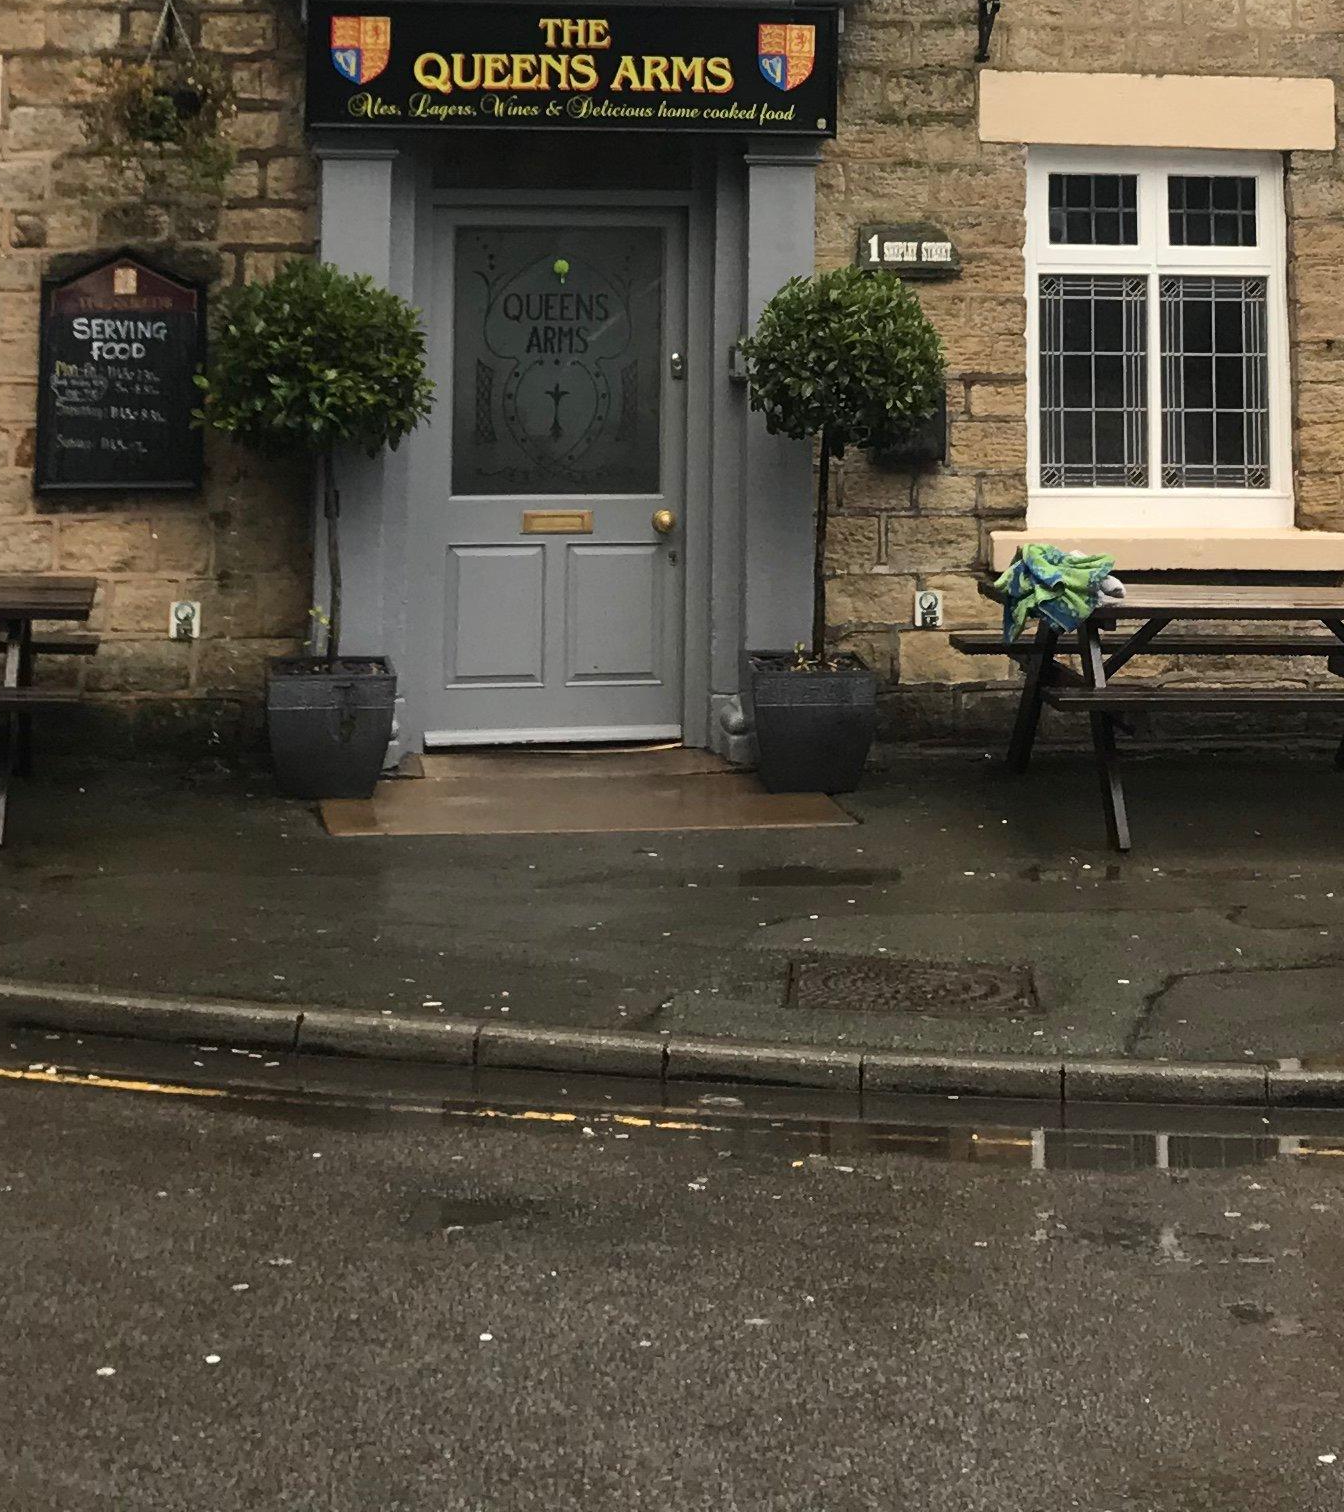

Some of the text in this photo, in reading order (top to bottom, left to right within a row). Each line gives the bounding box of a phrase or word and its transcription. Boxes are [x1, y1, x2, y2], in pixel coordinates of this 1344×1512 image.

[539, 18, 612, 49] THE
[413, 52, 735, 94] QUEENS ARMS
[480, 93, 539, 118] Wines
[546, 100, 563, 117] &
[567, 94, 655, 119] Delicious
[657, 100, 701, 119] home
[703, 102, 756, 120] cooked
[759, 103, 796, 125] food
[868, 234, 881, 262] 1
[503, 293, 609, 323] QUEENS
[72, 317, 168, 341] SERVING
[526, 326, 589, 354] ARMS
[90, 341, 146, 361] FOOD
